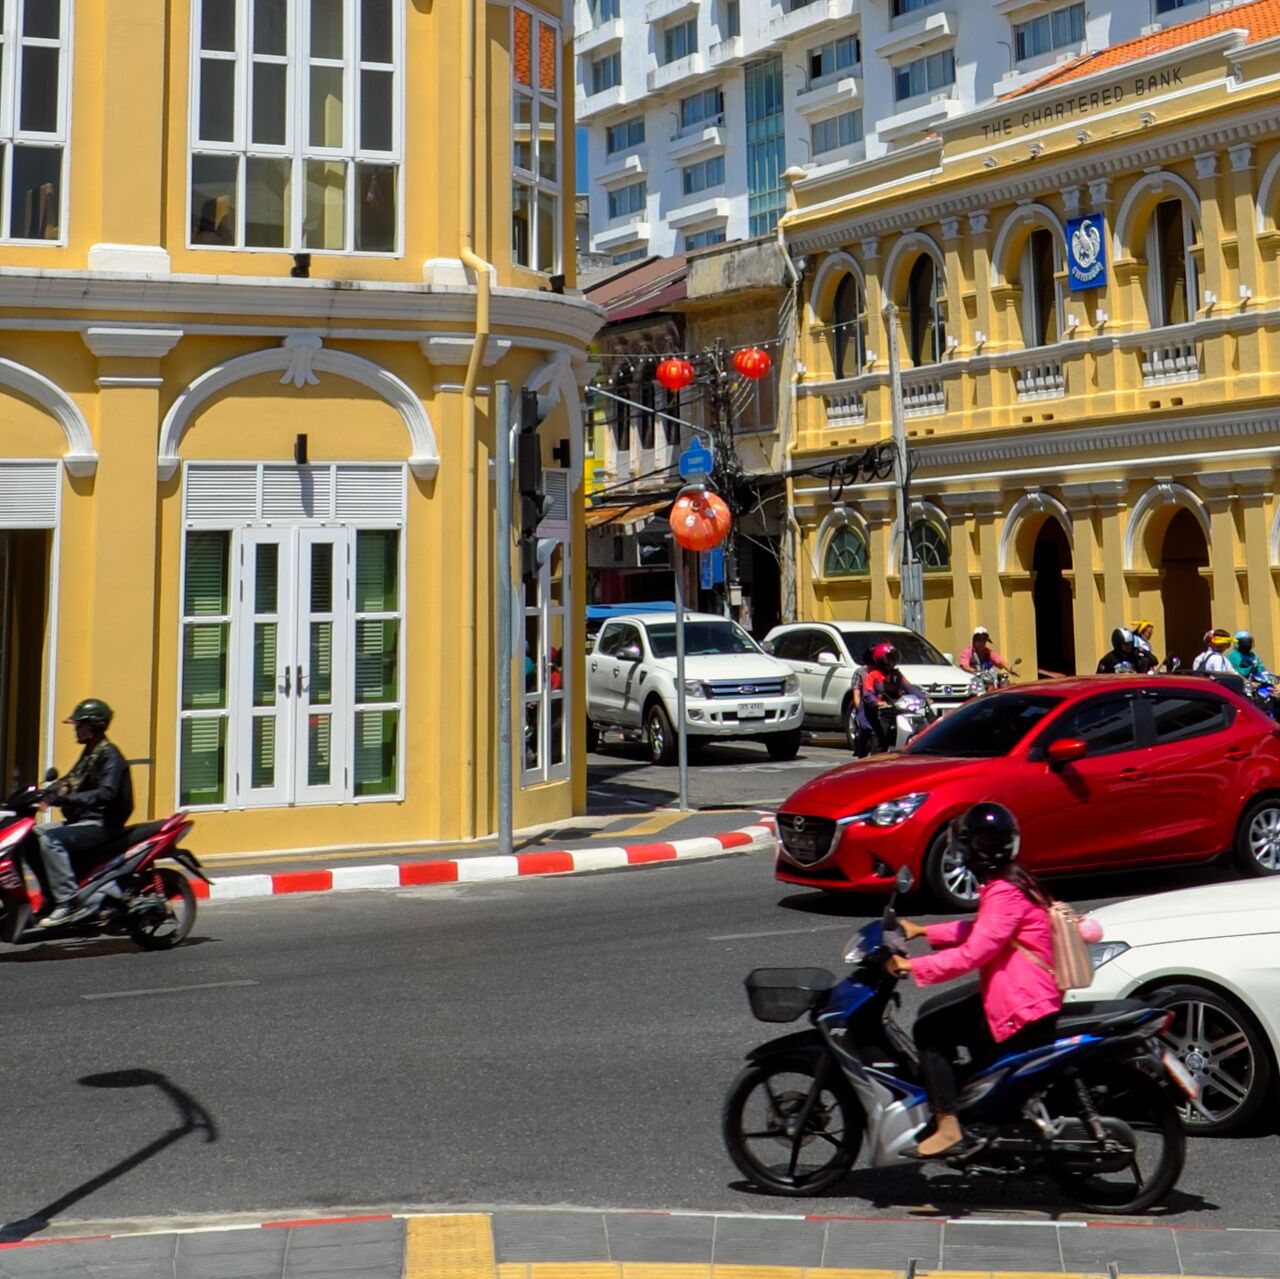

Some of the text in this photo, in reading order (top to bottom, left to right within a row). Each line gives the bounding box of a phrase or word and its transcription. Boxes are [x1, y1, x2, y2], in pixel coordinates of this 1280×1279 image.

[981, 66, 1183, 141] THE CHARTERED BANK
